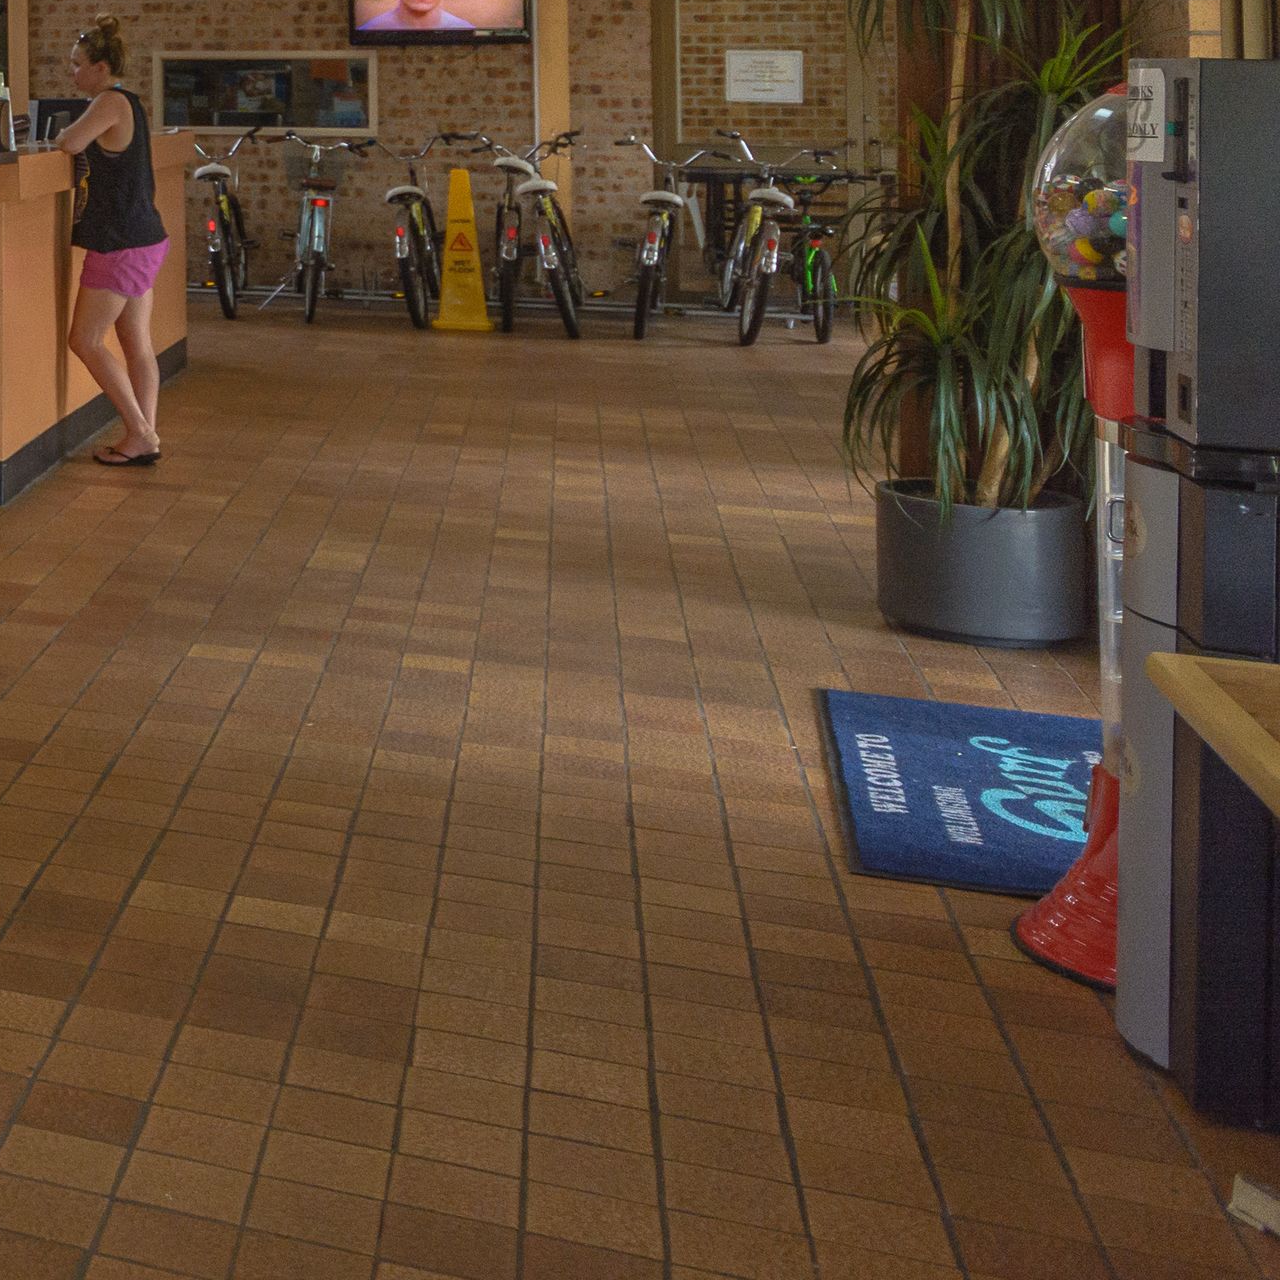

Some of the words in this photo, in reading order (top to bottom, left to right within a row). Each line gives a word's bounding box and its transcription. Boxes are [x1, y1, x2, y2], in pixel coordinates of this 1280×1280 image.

[855, 734, 892, 750] TO
[861, 749, 909, 814] WELCOME
[969, 736, 1090, 844] Surf
